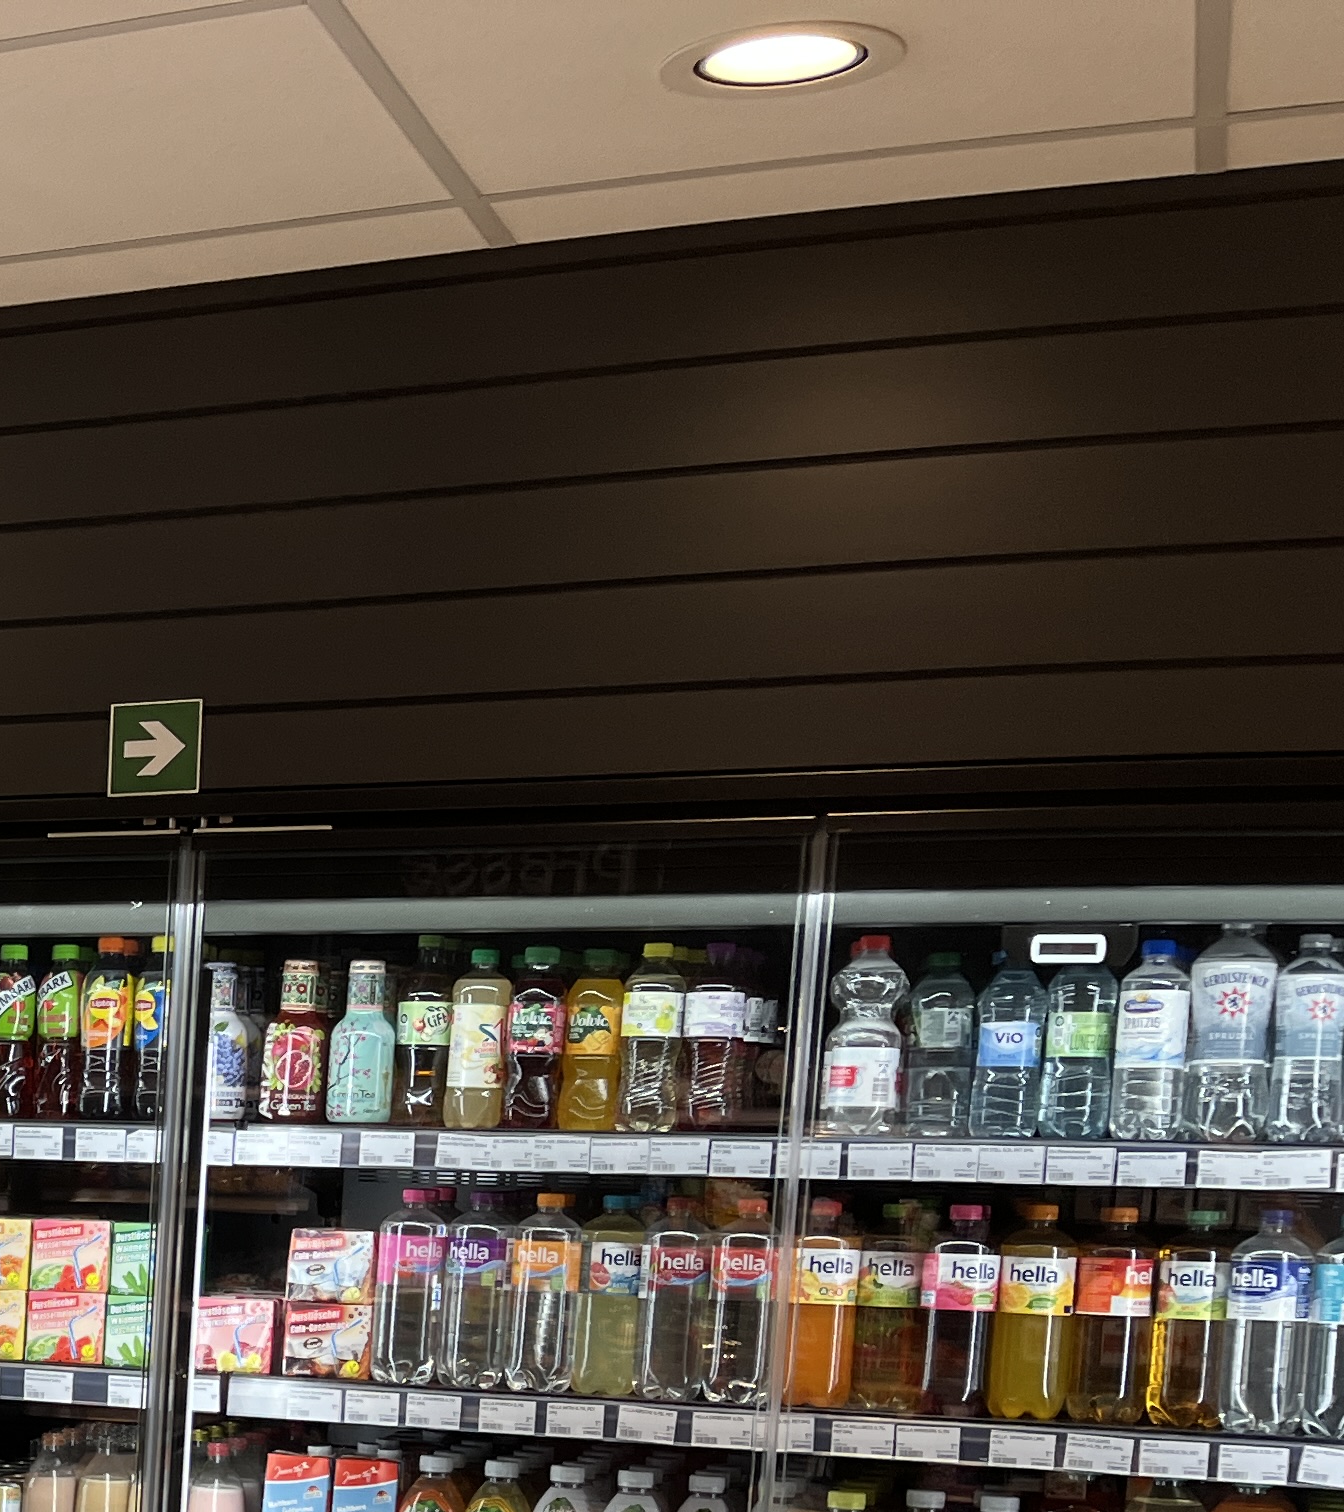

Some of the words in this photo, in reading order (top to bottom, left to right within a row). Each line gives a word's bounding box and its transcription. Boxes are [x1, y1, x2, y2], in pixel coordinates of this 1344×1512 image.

[995, 1031, 1023, 1045] ViO
[405, 1240, 442, 1259] hella
[449, 1242, 489, 1263] hella
[518, 1246, 559, 1265] hella
[601, 1248, 642, 1268] hella
[660, 1252, 704, 1271] hella
[719, 1253, 766, 1271] hella
[810, 1256, 853, 1275] hella
[868, 1258, 914, 1277] hella
[952, 1261, 995, 1280] hella
[1010, 1263, 1057, 1284] hella
[1126, 1267, 1152, 1285] hel
[1170, 1269, 1216, 1288] hella
[1233, 1267, 1276, 1288] hella
